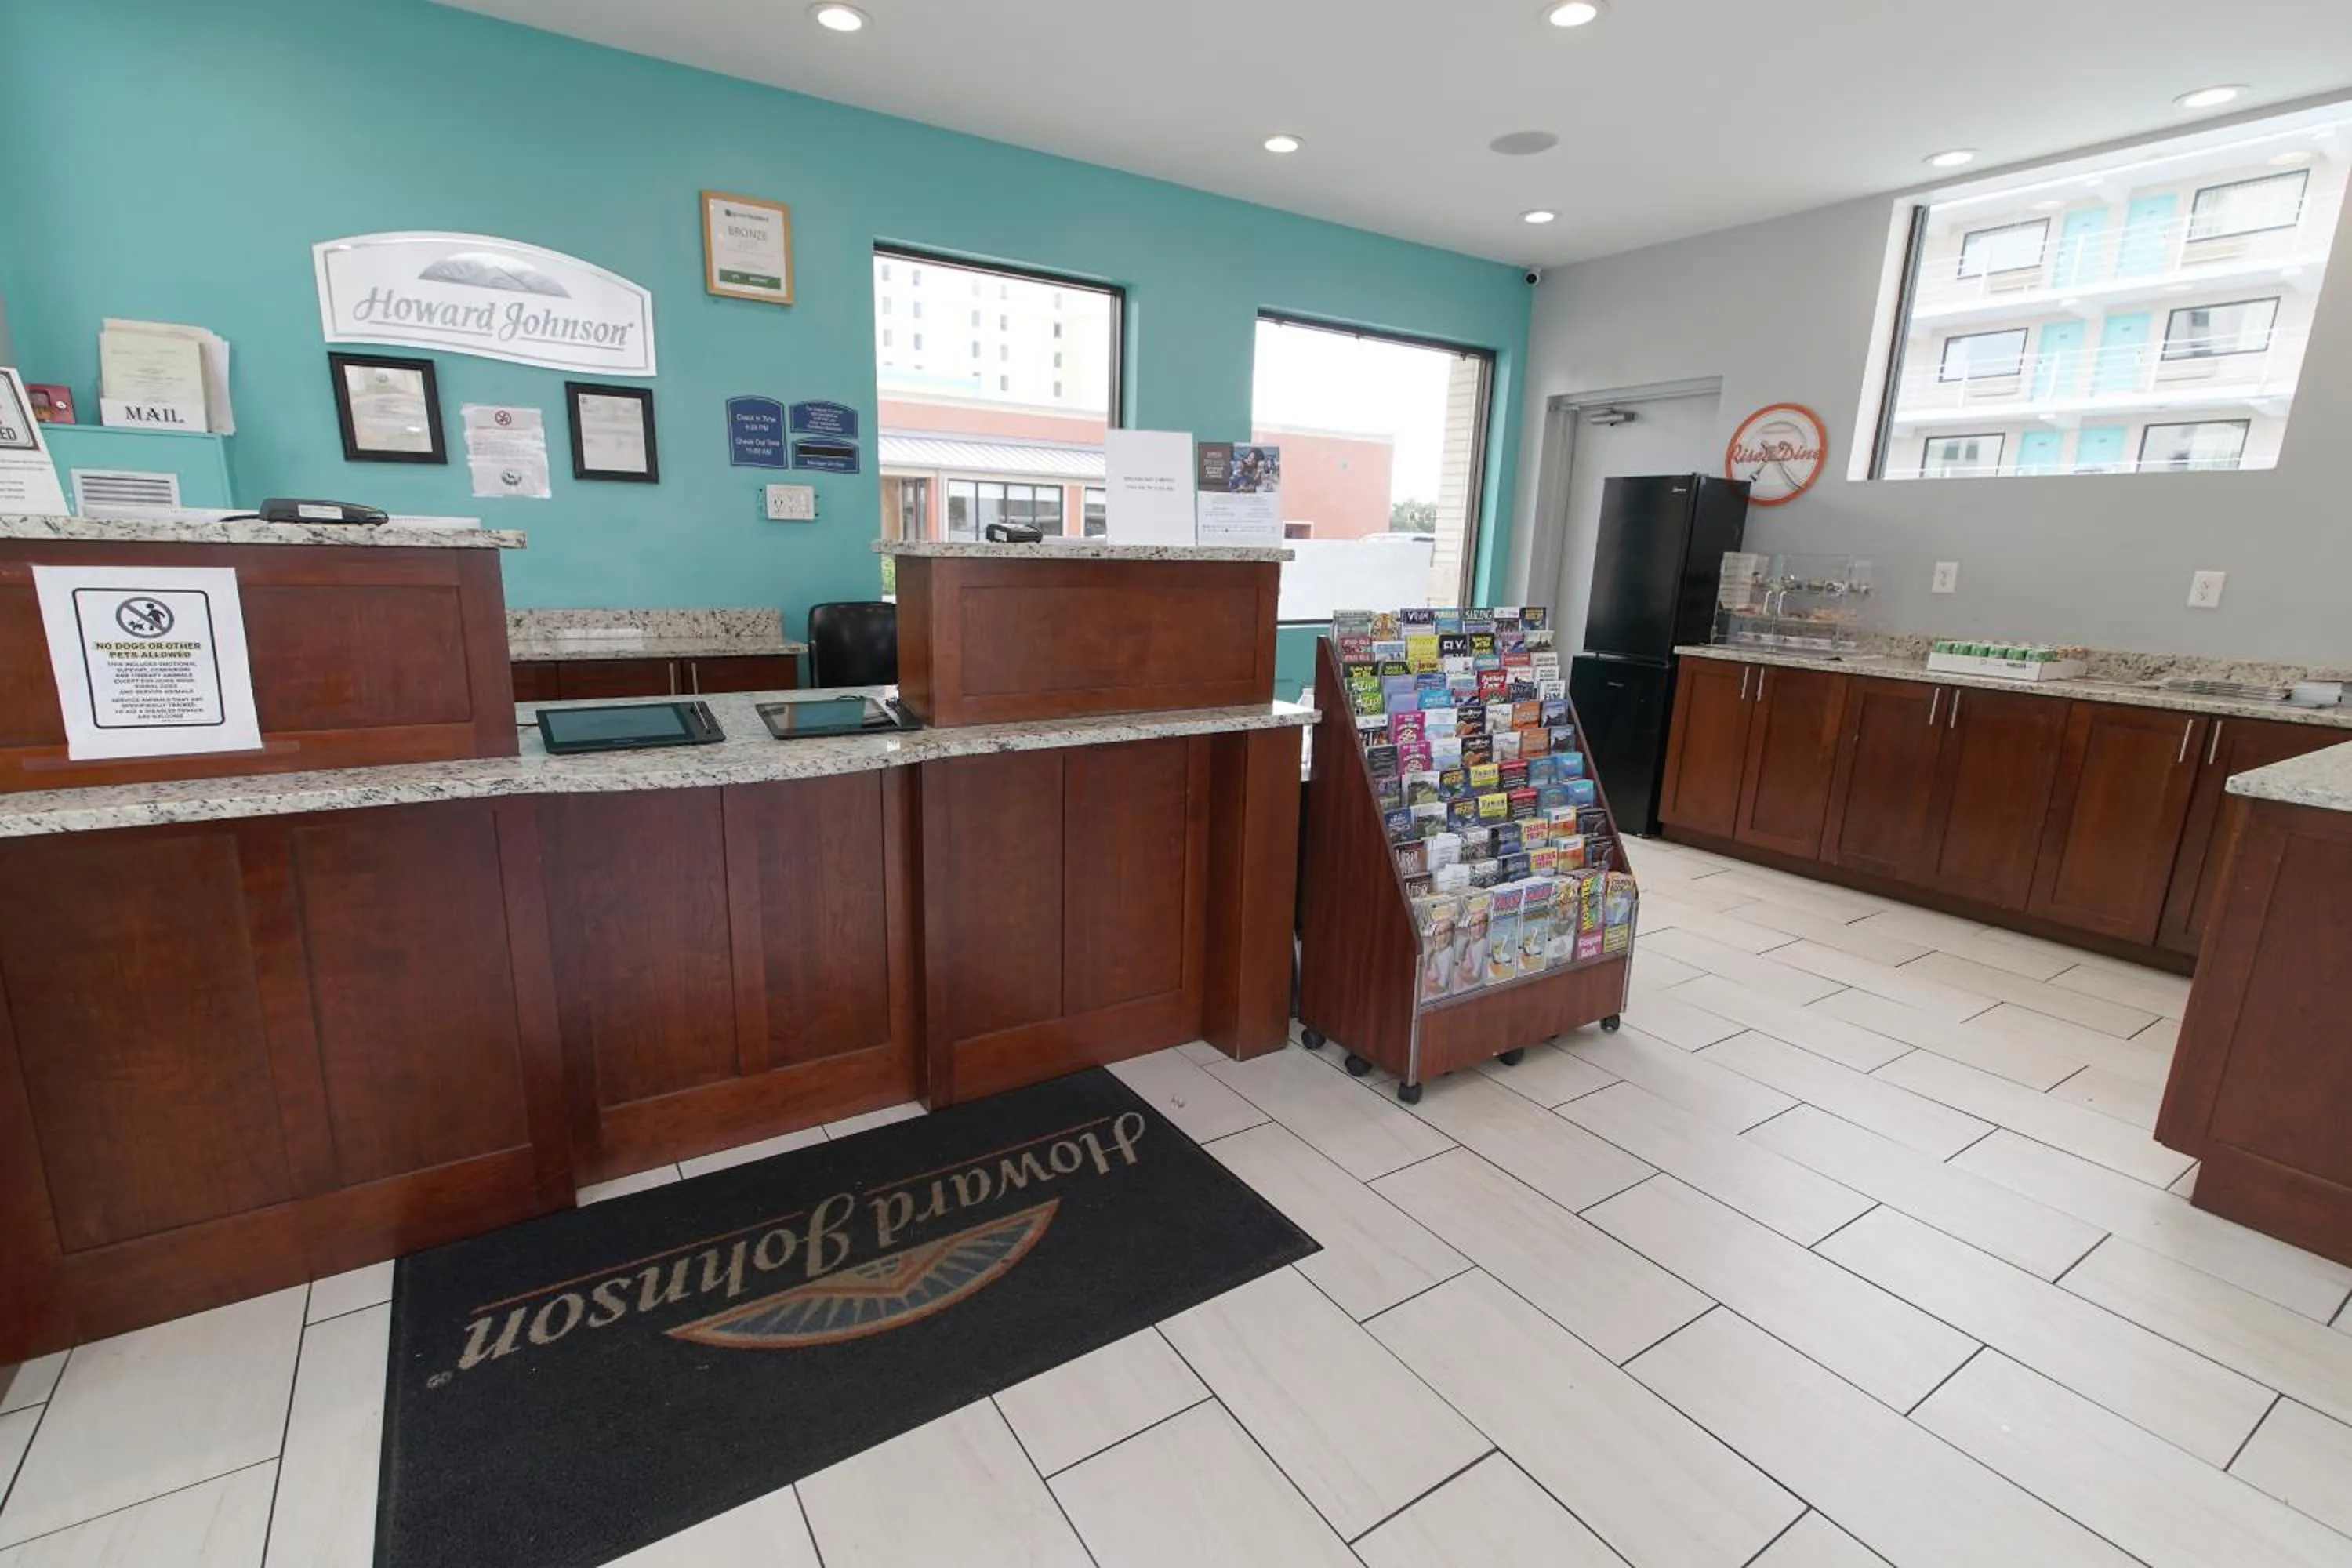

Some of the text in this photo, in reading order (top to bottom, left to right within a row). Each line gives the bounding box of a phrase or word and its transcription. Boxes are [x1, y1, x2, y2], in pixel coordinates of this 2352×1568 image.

[353, 287, 495, 332] Howard
[125, 405, 186, 424] MAIL
[456, 1111, 1147, 1371] Howard Johnson
